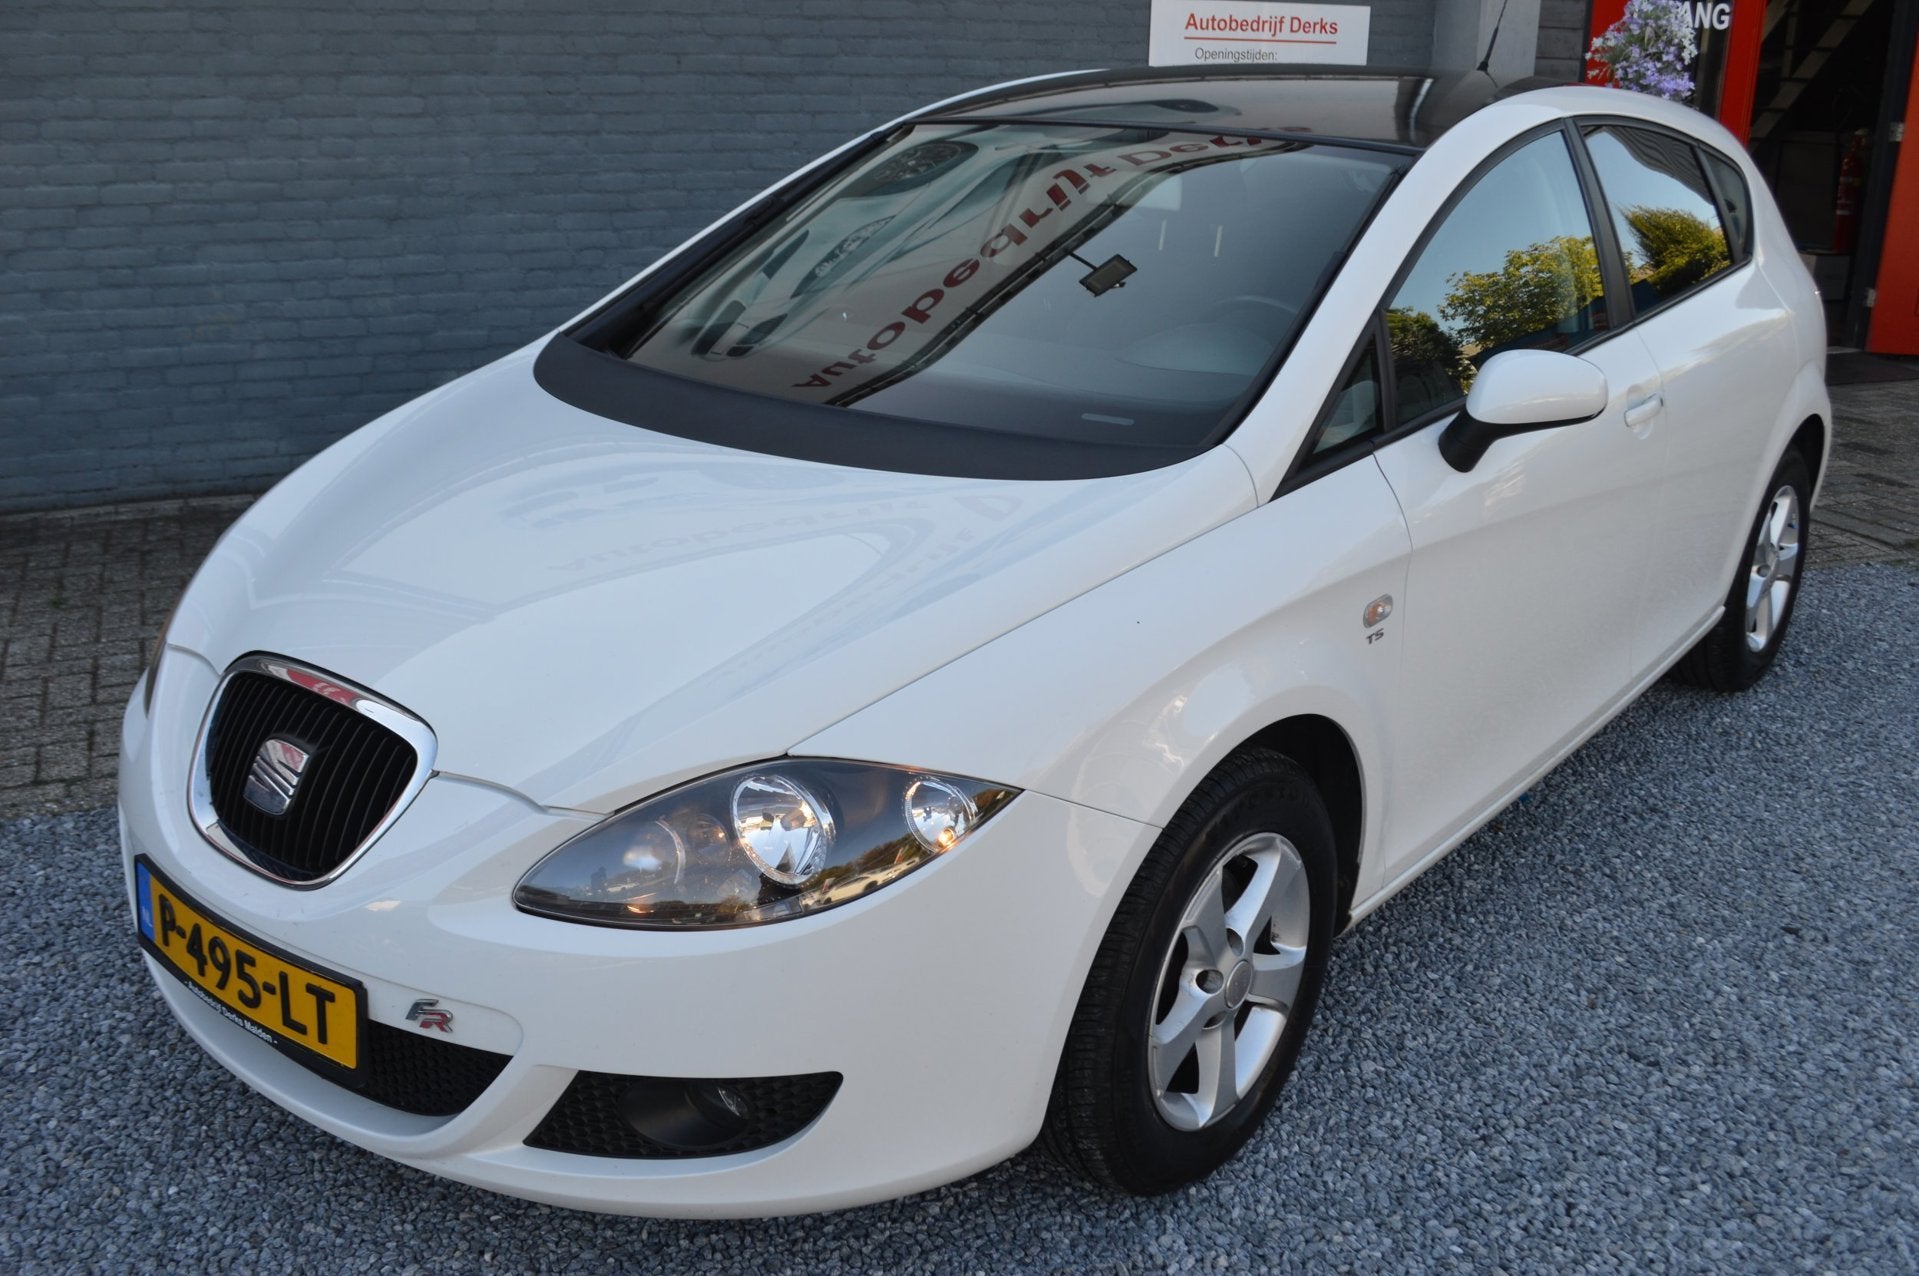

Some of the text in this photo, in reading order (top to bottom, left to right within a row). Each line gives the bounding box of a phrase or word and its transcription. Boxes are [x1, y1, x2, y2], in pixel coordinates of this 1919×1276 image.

[1184, 12, 1338, 37] Autobedrijf Derks
[1681, 1, 1730, 30] ANG
[1194, 47, 1278, 63] Openingstijden:
[159, 893, 336, 1045] P-495-LT
[405, 998, 454, 1034] FR
